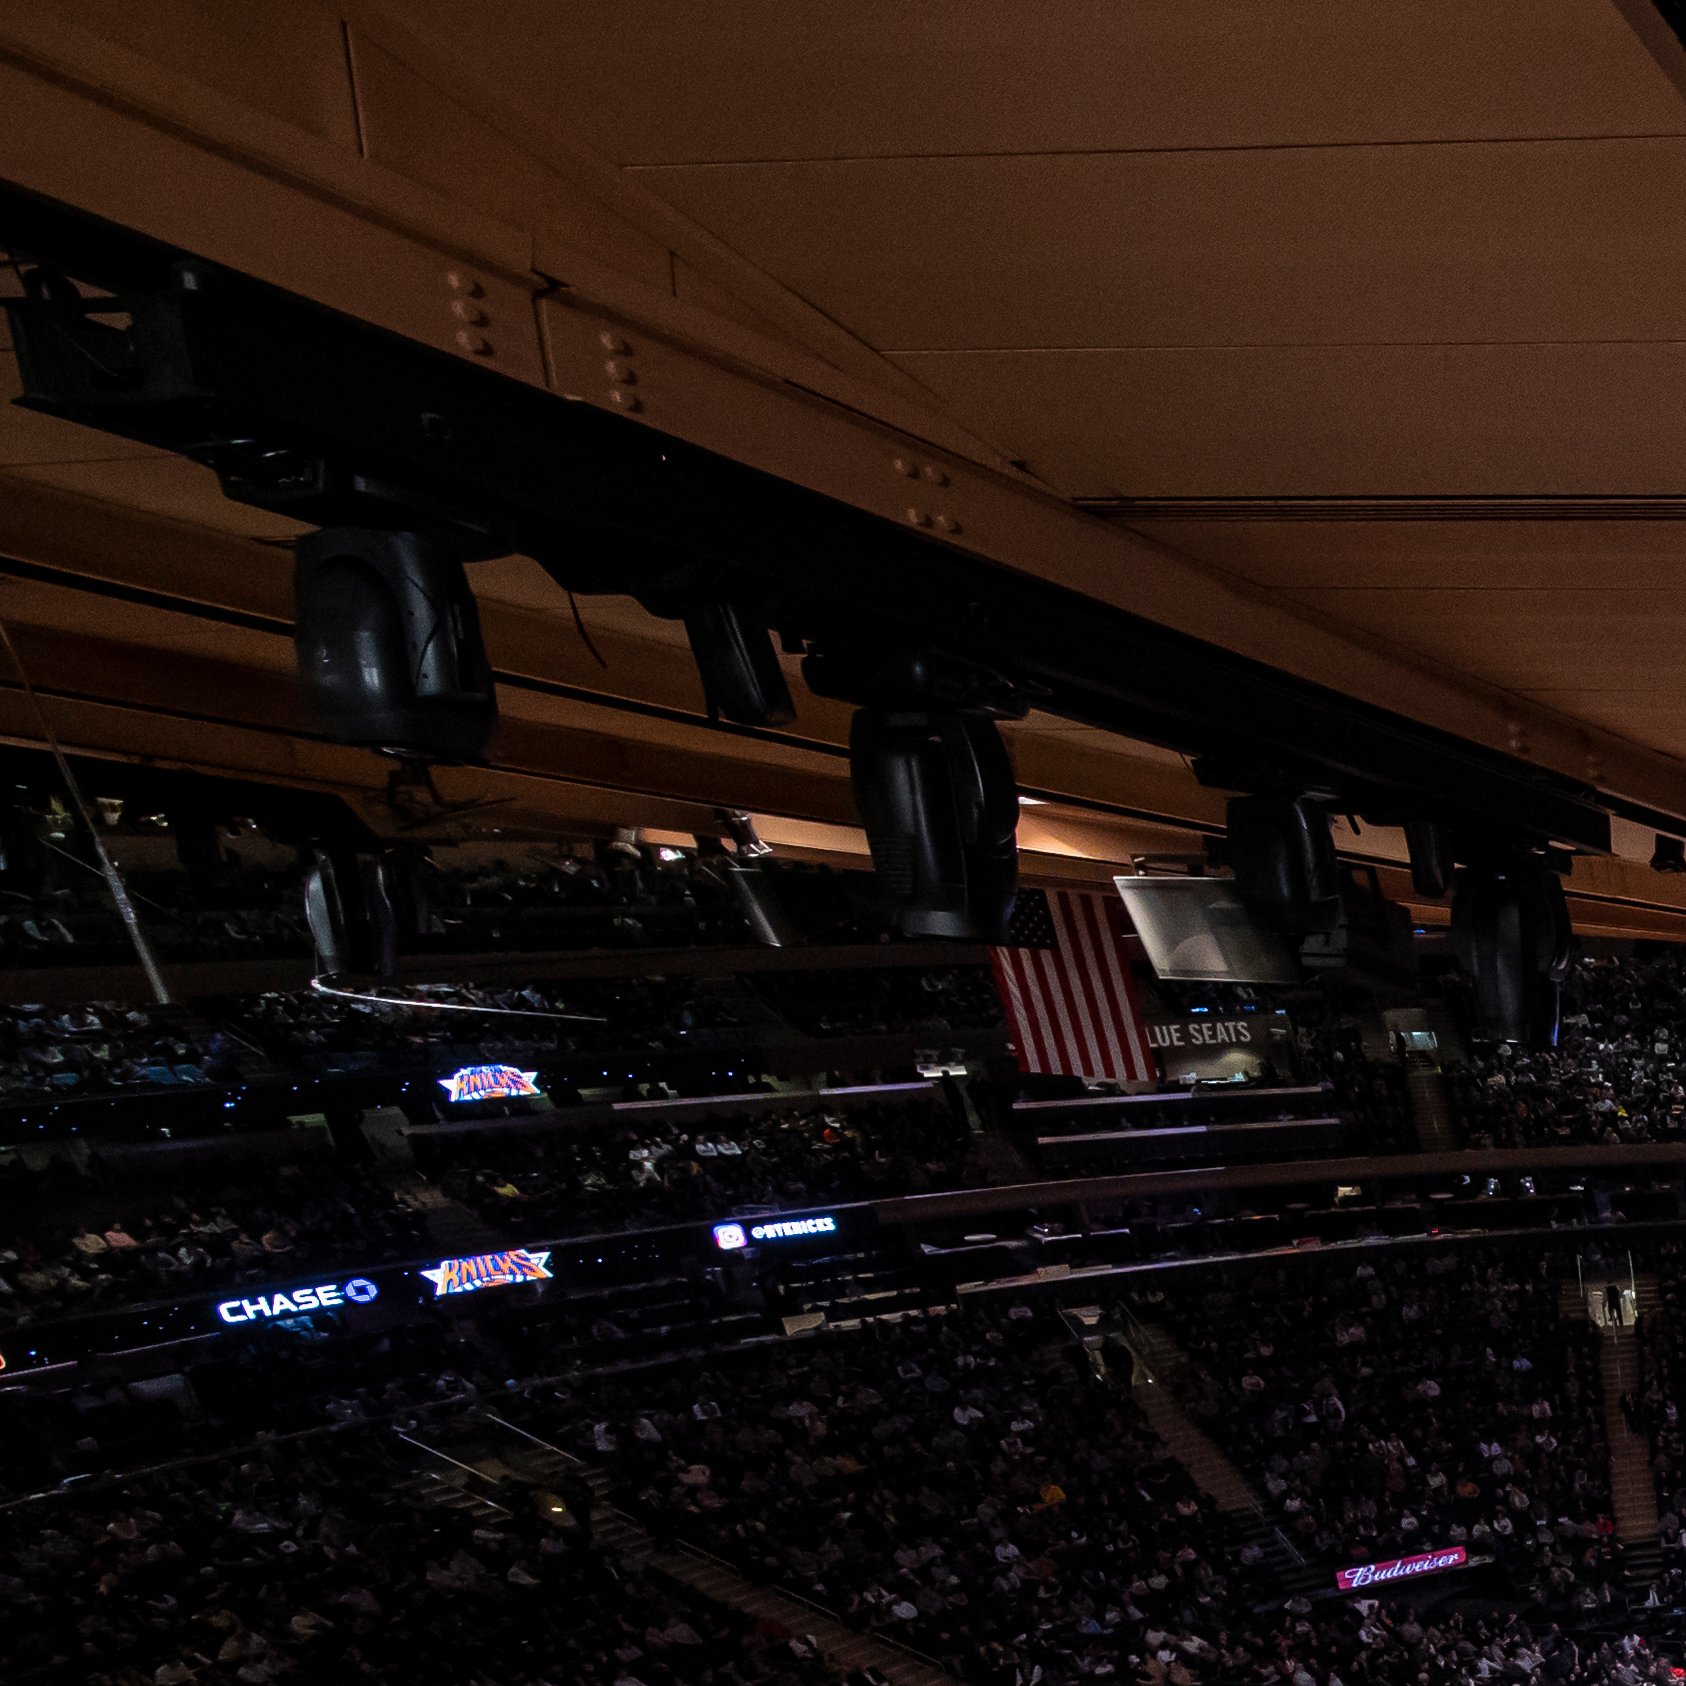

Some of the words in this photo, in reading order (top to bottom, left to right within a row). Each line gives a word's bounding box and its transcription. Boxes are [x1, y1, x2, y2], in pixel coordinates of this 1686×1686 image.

[1145, 1024, 1185, 1048] LUE
[1188, 1021, 1251, 1044] SEATS
[440, 1251, 546, 1294] KNICKS
[219, 1283, 345, 1324] CHASE
[1345, 1553, 1459, 1587] Budweiser
